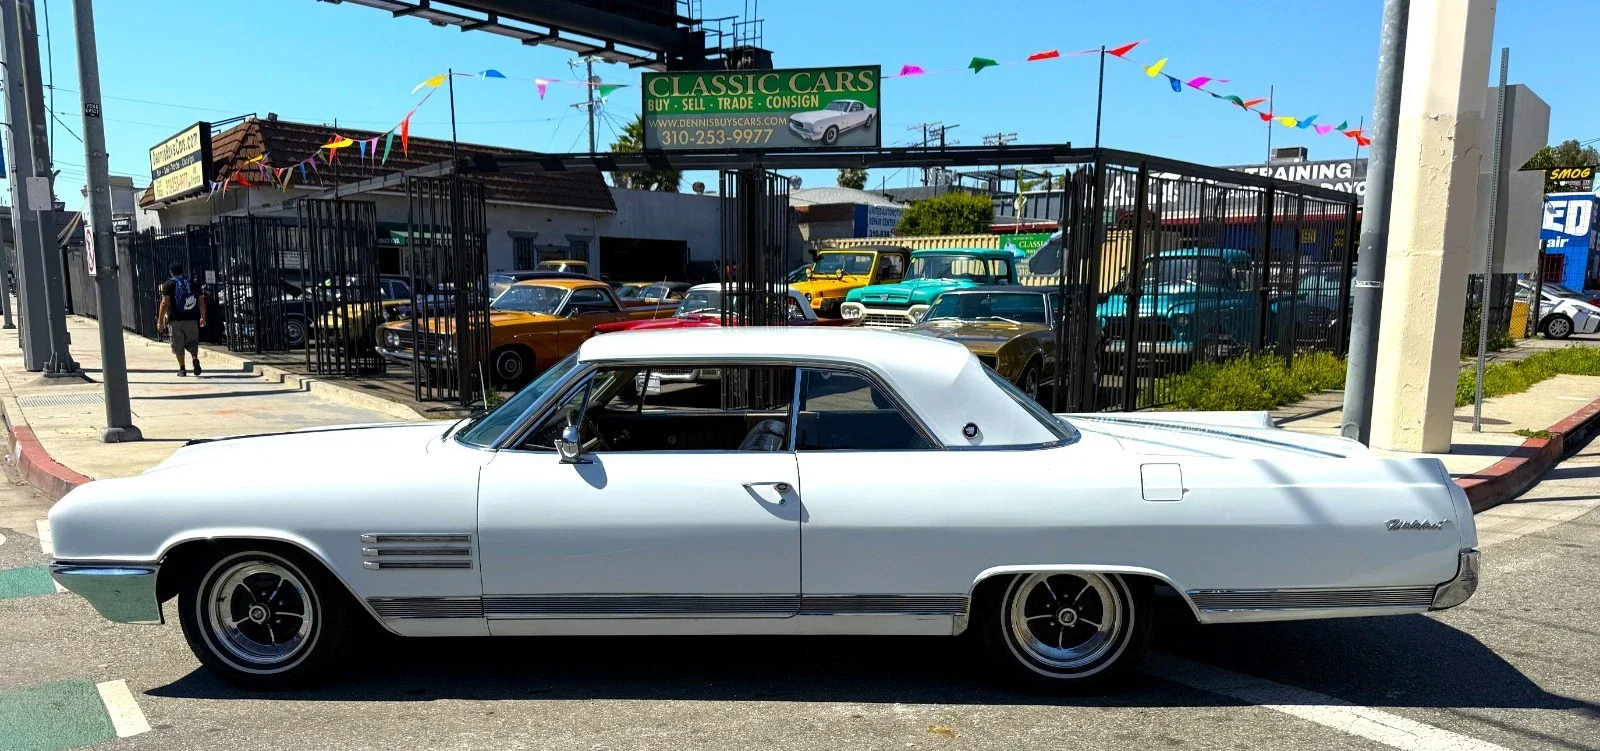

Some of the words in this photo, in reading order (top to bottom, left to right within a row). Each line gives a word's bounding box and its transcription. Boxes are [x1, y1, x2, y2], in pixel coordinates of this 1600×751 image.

[648, 73, 780, 97] CLASSIC
[788, 70, 875, 94] CARS
[647, 98, 670, 111] BUY
[682, 97, 705, 110] SELL
[717, 96, 753, 110] TRADE
[766, 94, 819, 109] CONSIGN
[648, 116, 787, 128] WWW.DENNISBUYSCARS.COM
[661, 128, 773, 146] 310-253-9977
[1244, 162, 1352, 182] TRAINING
[1549, 167, 1591, 180] SMOG
[1542, 200, 1592, 236] ED
[1018, 240, 1046, 248] CLASSI
